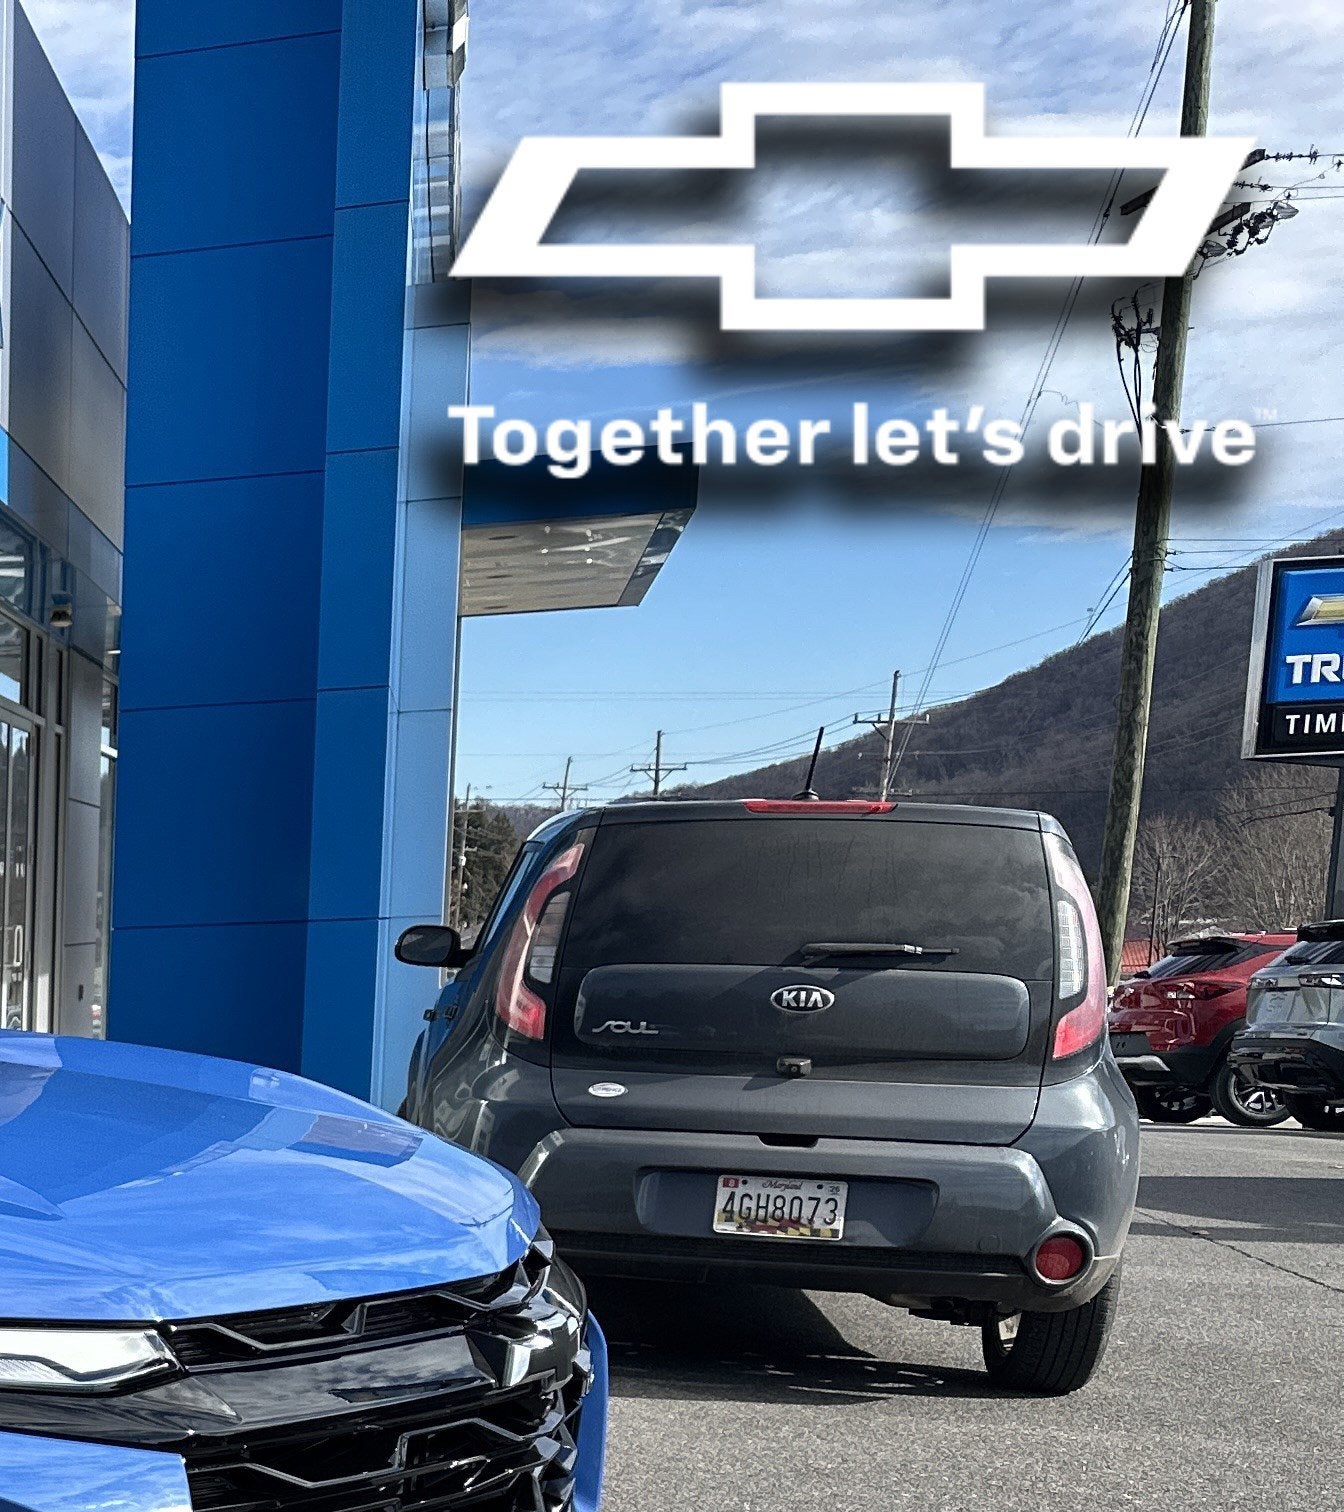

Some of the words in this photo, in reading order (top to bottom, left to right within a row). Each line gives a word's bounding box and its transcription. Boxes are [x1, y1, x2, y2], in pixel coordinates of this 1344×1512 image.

[1286, 654, 1344, 684] TR
[1286, 713, 1344, 735] TIM
[781, 990, 824, 1008] KIA
[592, 1020, 659, 1035] SOUL
[761, 1179, 803, 1192] Maryland
[722, 1190, 839, 1226] 4GH8073
